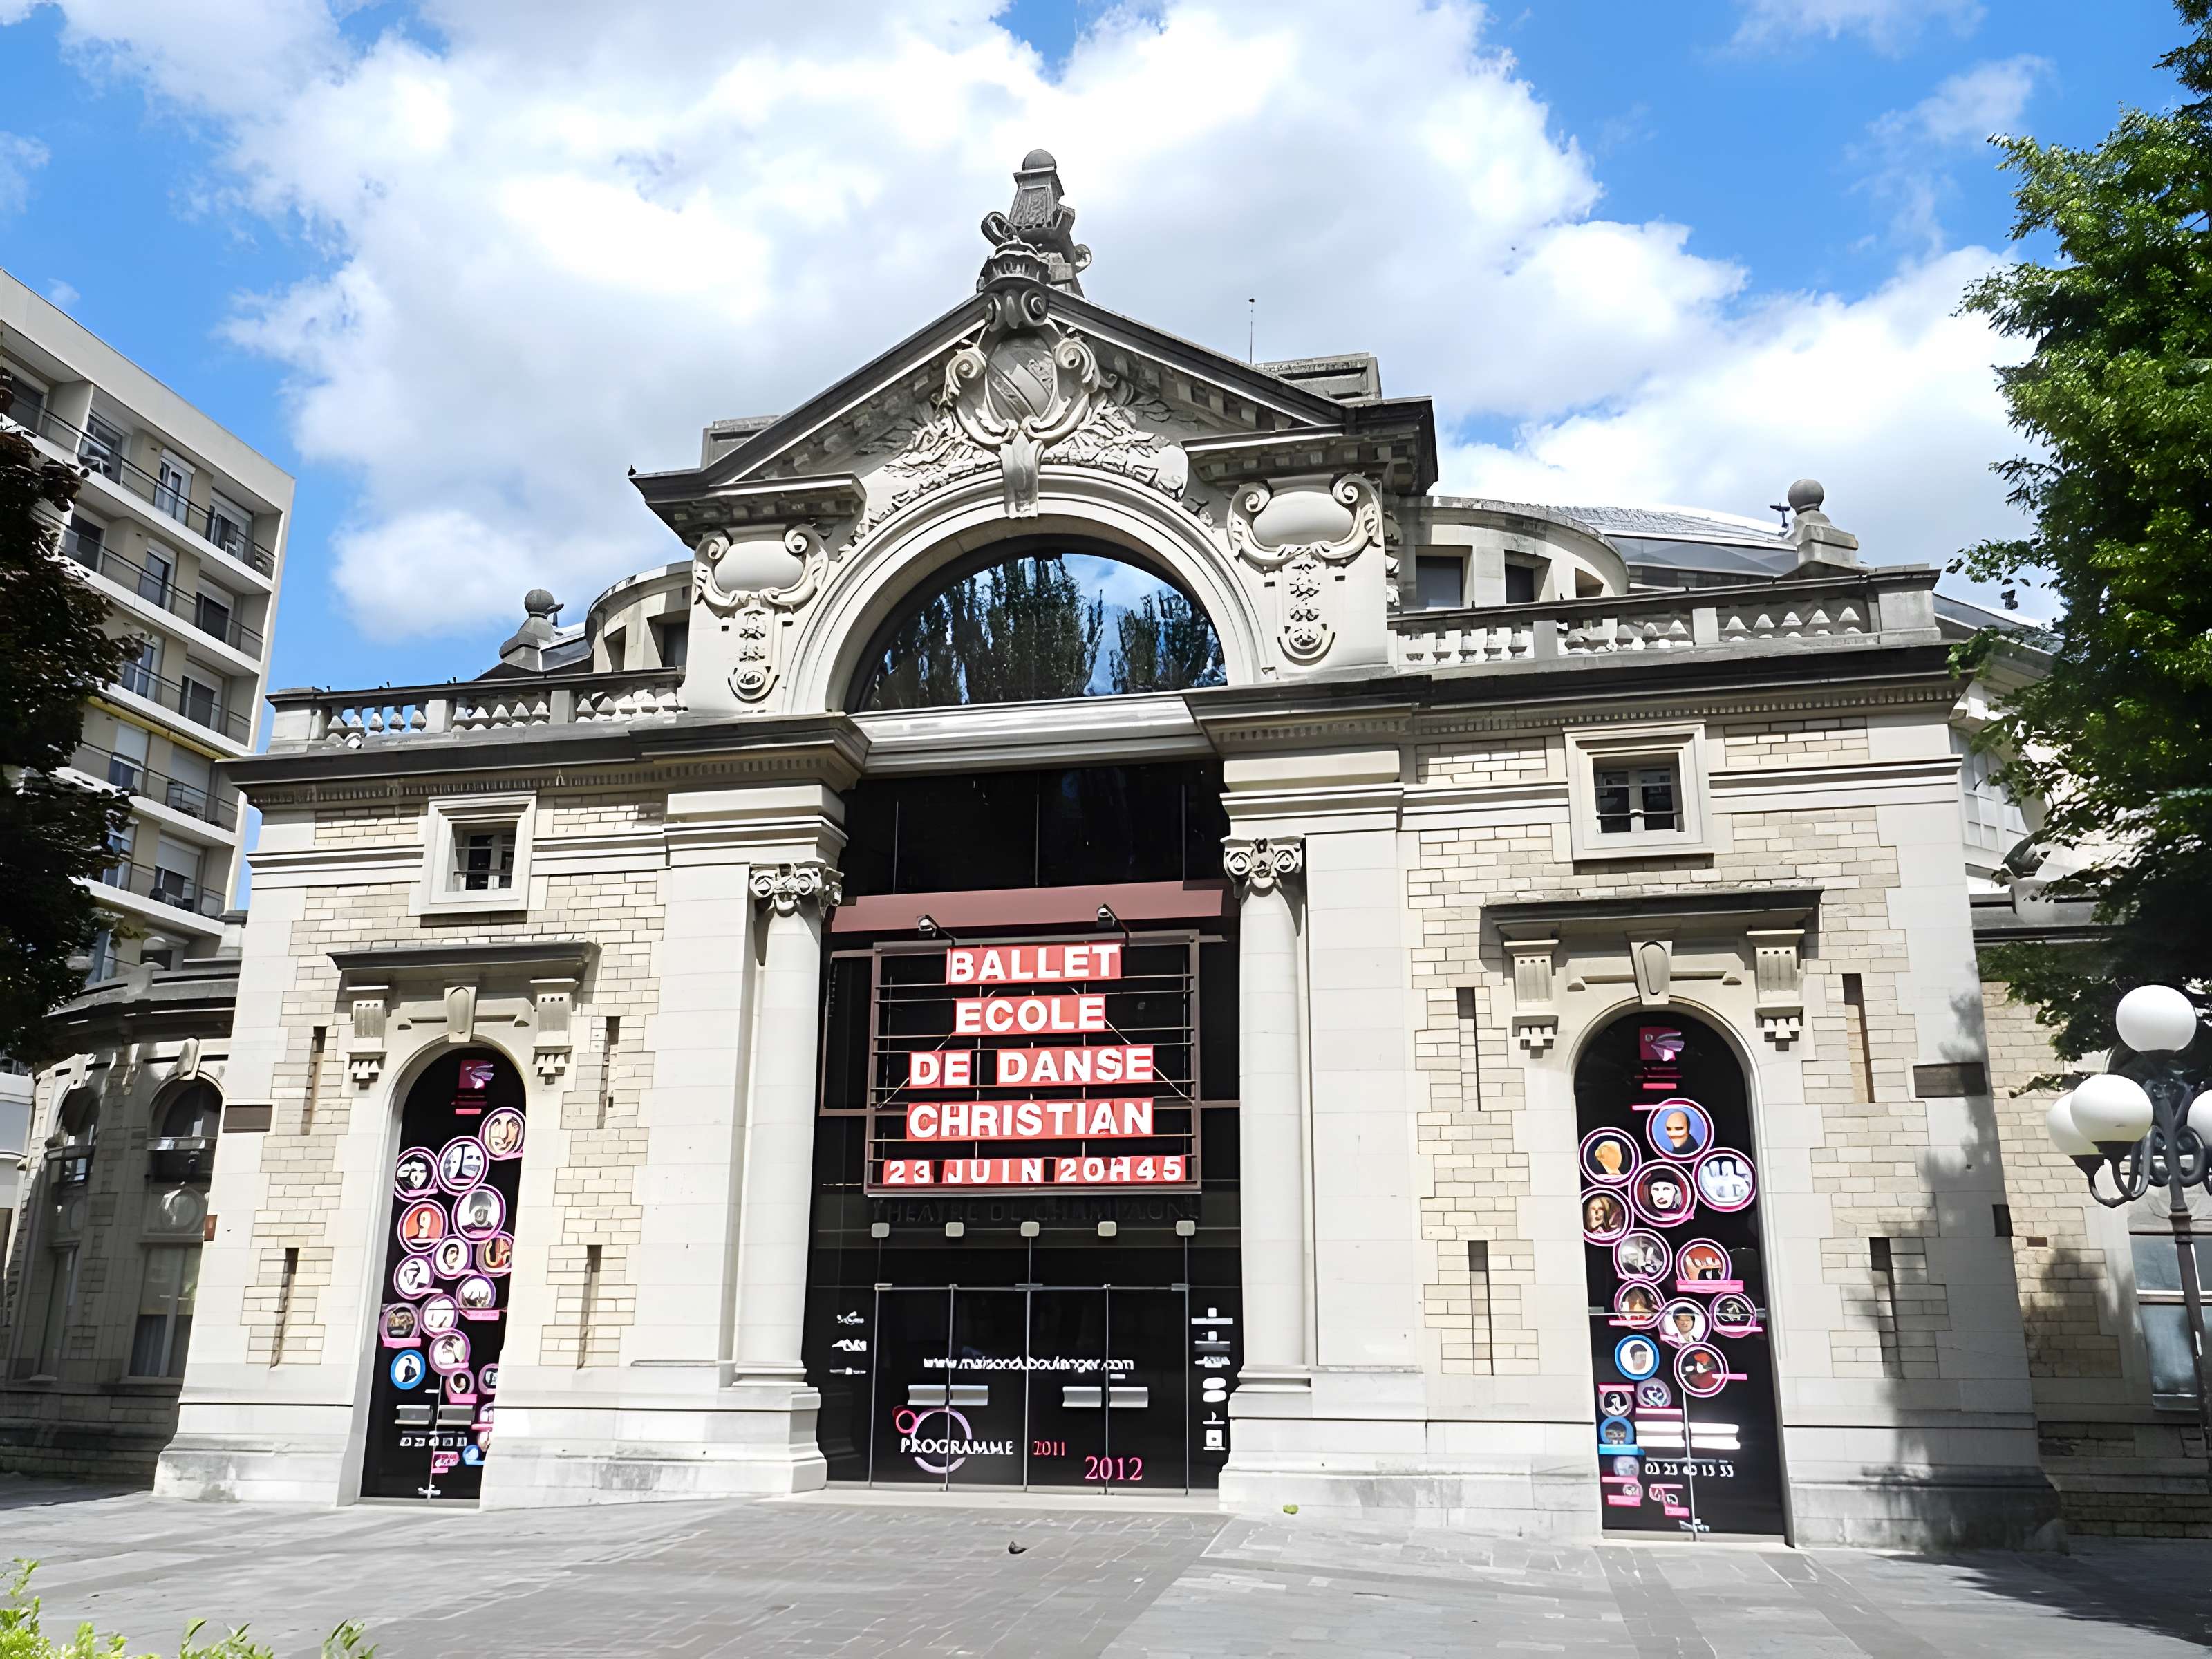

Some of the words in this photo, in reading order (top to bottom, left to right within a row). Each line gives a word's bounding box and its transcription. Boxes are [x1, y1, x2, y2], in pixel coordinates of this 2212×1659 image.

[950, 944, 1120, 982] BALLET
[956, 997, 1104, 1033] ECOLE
[911, 1053, 969, 1085] DE
[1000, 1047, 1152, 1082] DANSE
[909, 1102, 1152, 1137] CHRISTIAN
[888, 1161, 930, 1183] 23
[947, 1159, 1042, 1183] JUIN
[1059, 1156, 1181, 1182] 20H45
[901, 1438, 1013, 1455] PROGRAMME
[1033, 1441, 1065, 1456] 2011
[1085, 1456, 1143, 1481] 2012
